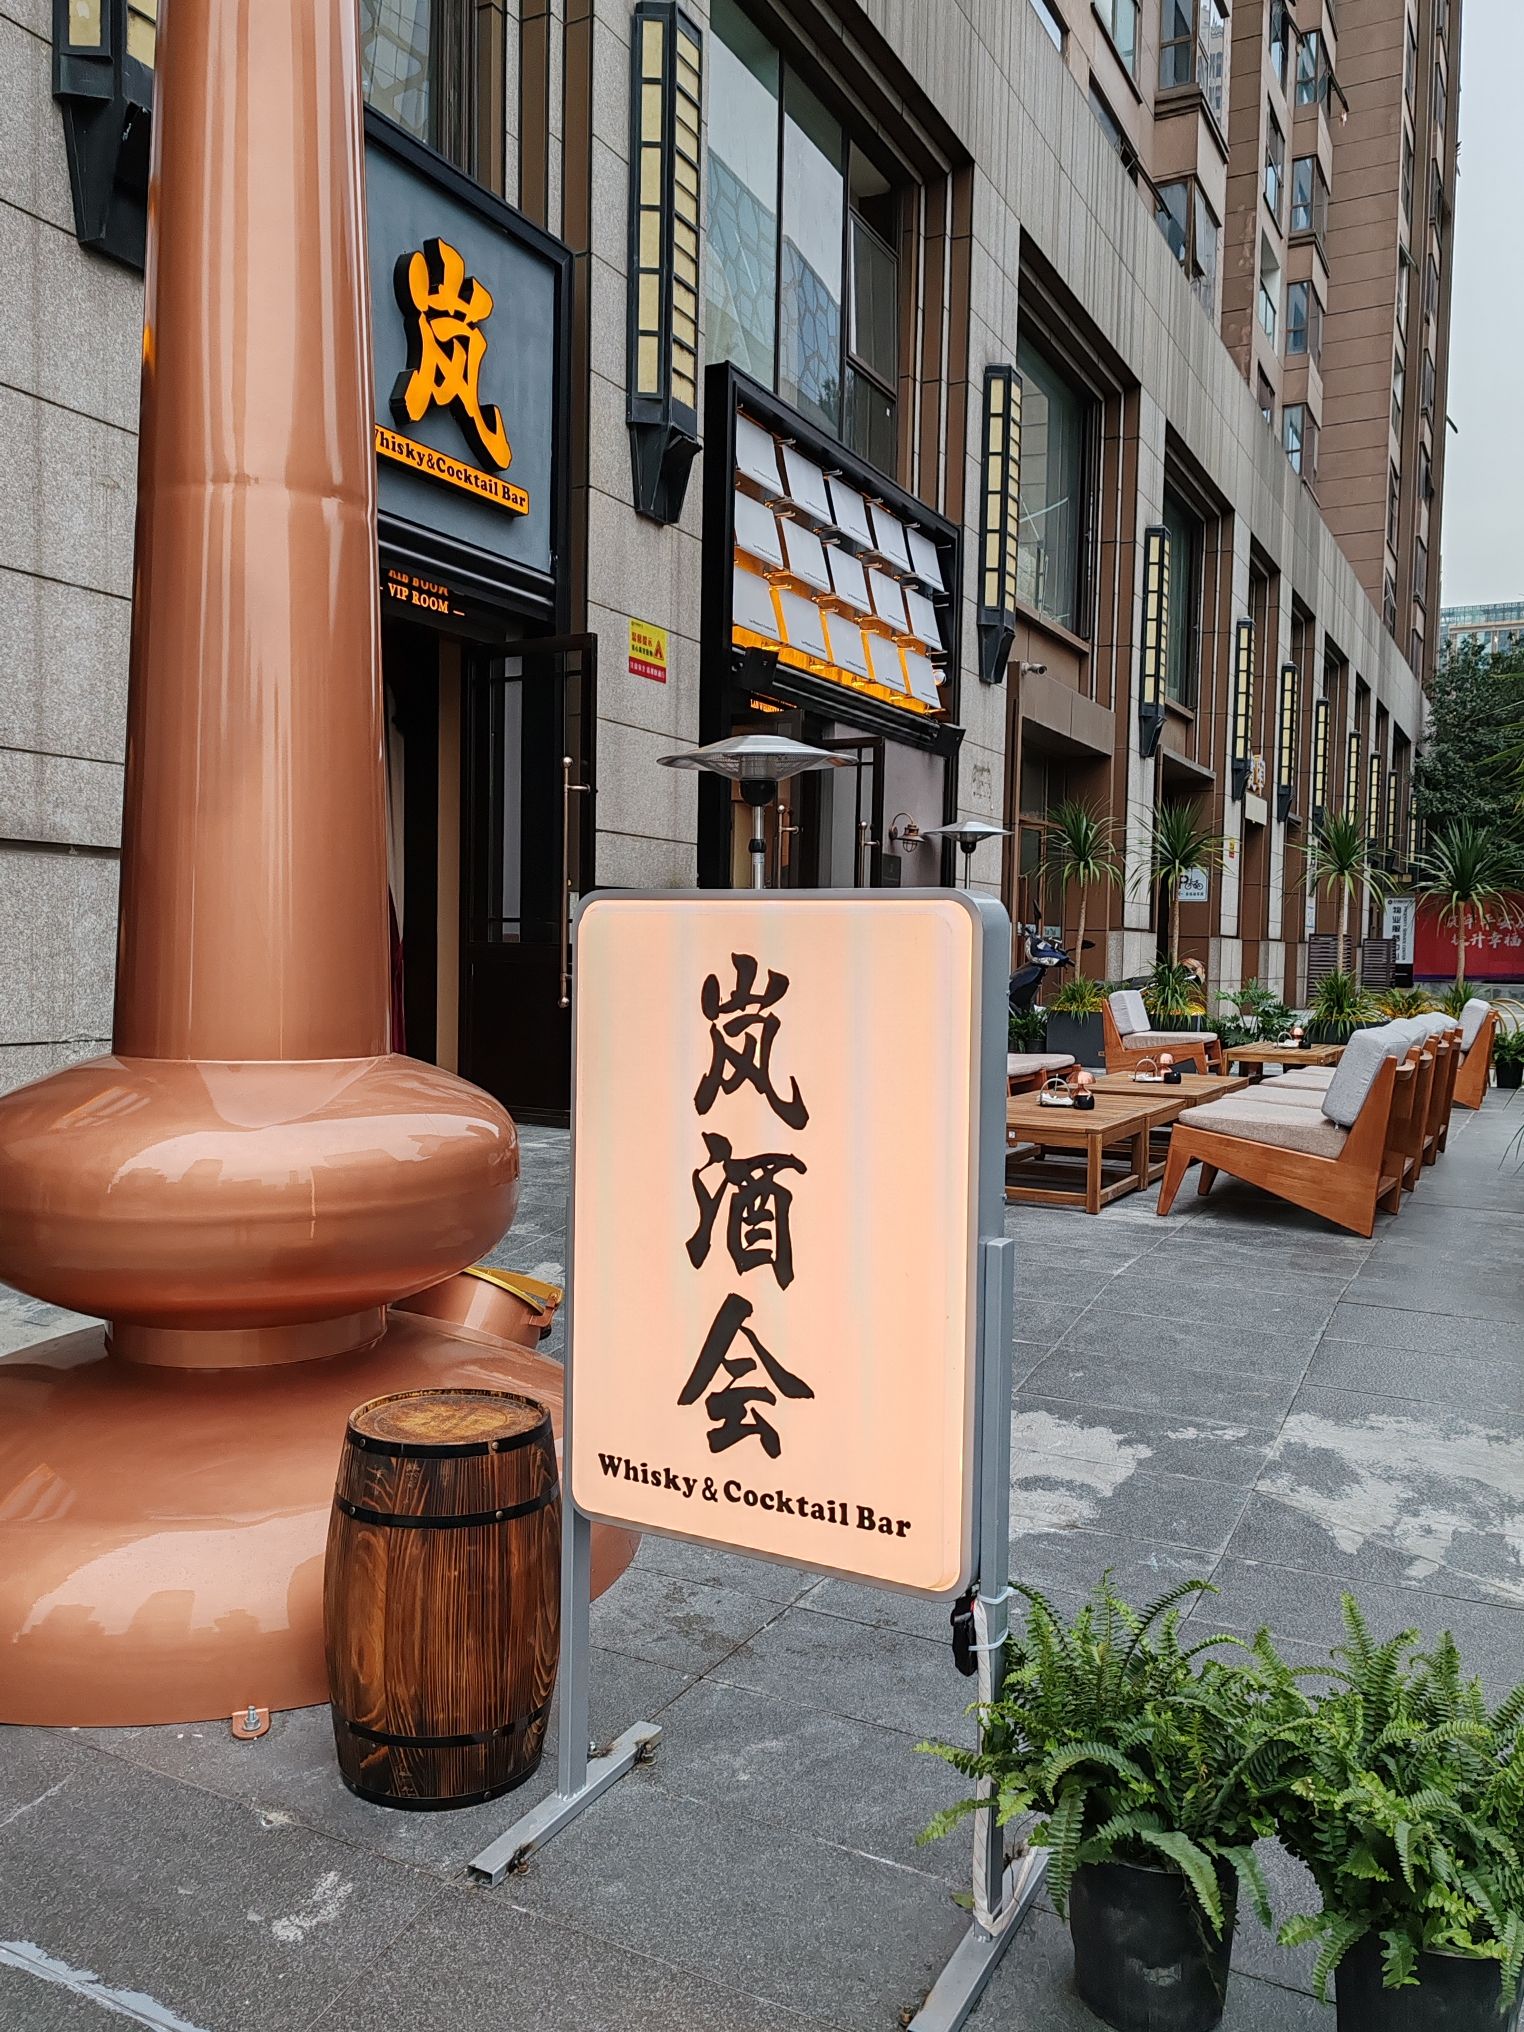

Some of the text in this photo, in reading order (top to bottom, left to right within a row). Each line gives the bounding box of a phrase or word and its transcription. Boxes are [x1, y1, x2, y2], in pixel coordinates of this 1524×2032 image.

[404, 237, 513, 471] 岚
[502, 485, 526, 508] Bar
[387, 582, 409, 601] VIP
[412, 590, 449, 614] ROOM
[677, 953, 814, 1459] 岚酒会
[597, 1452, 912, 1538] Whisky & Cocktail Bar
